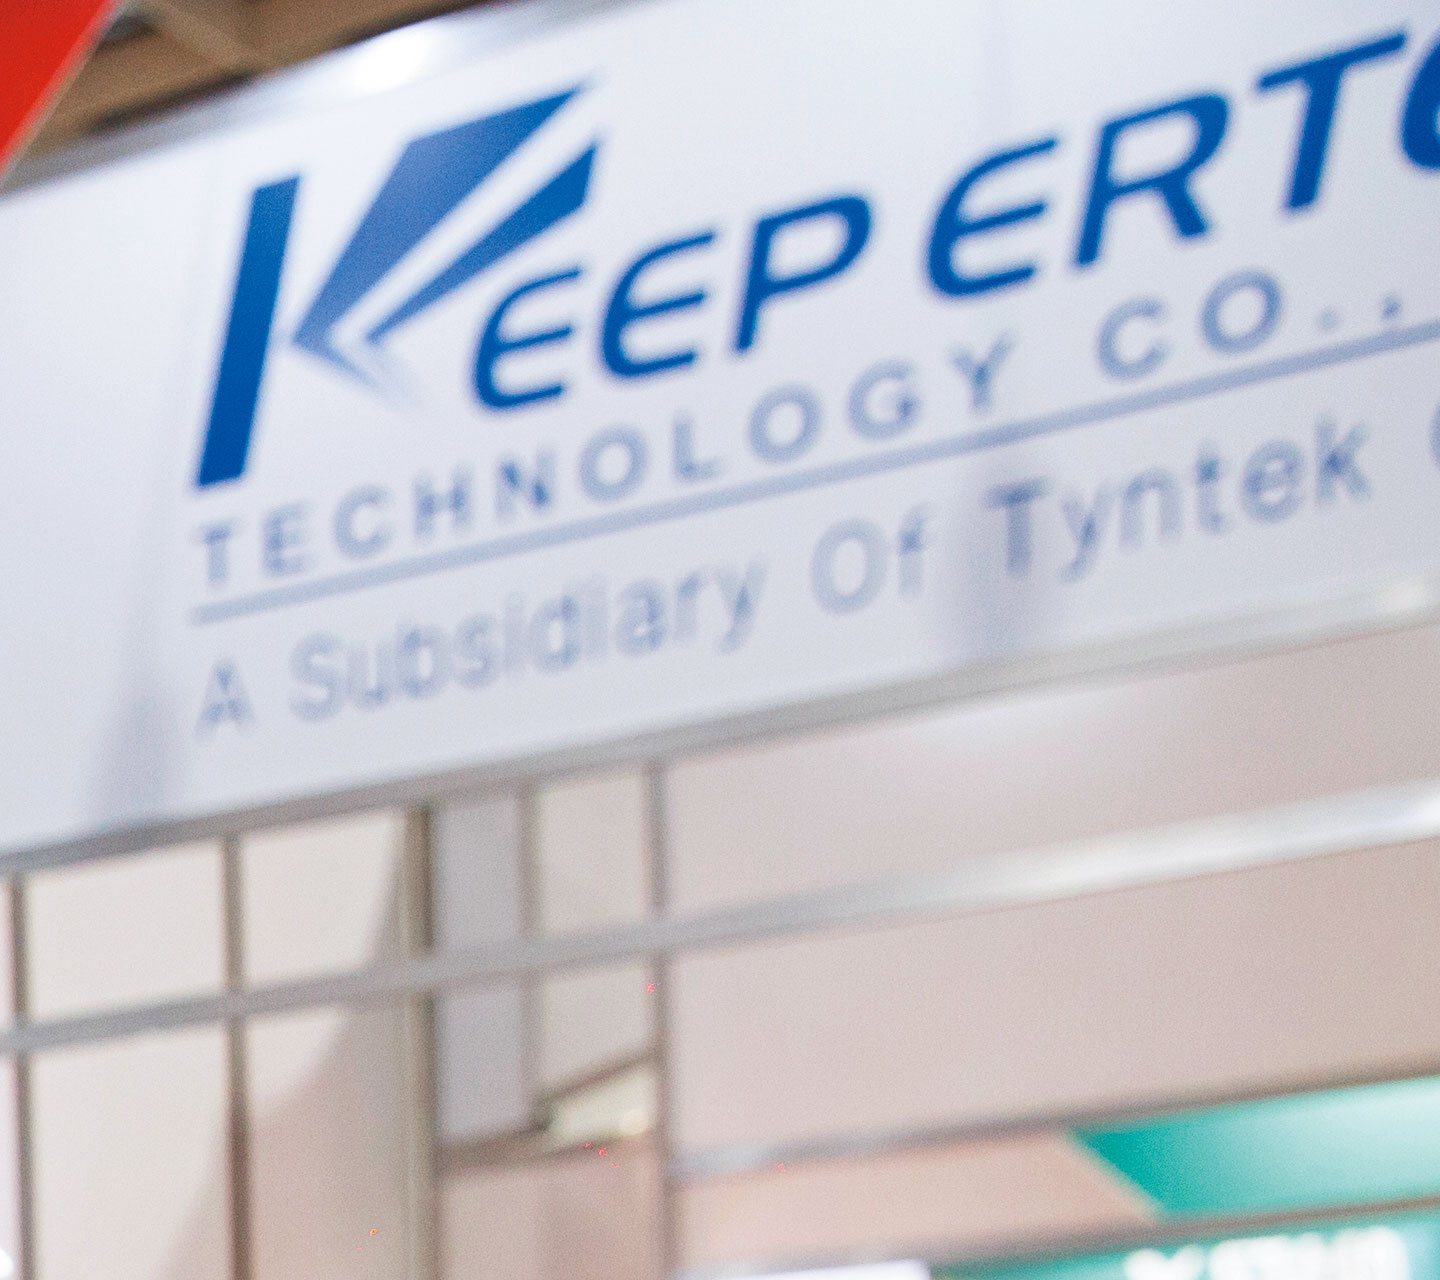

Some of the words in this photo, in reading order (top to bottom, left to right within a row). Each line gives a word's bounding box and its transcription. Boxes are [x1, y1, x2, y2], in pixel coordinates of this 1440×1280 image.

[192, 335, 1020, 590] TECHNOLOGY
[192, 650, 256, 744] A
[282, 552, 770, 726] Subsidiary
[808, 506, 932, 618] Of
[985, 410, 1378, 586] Tyntek
